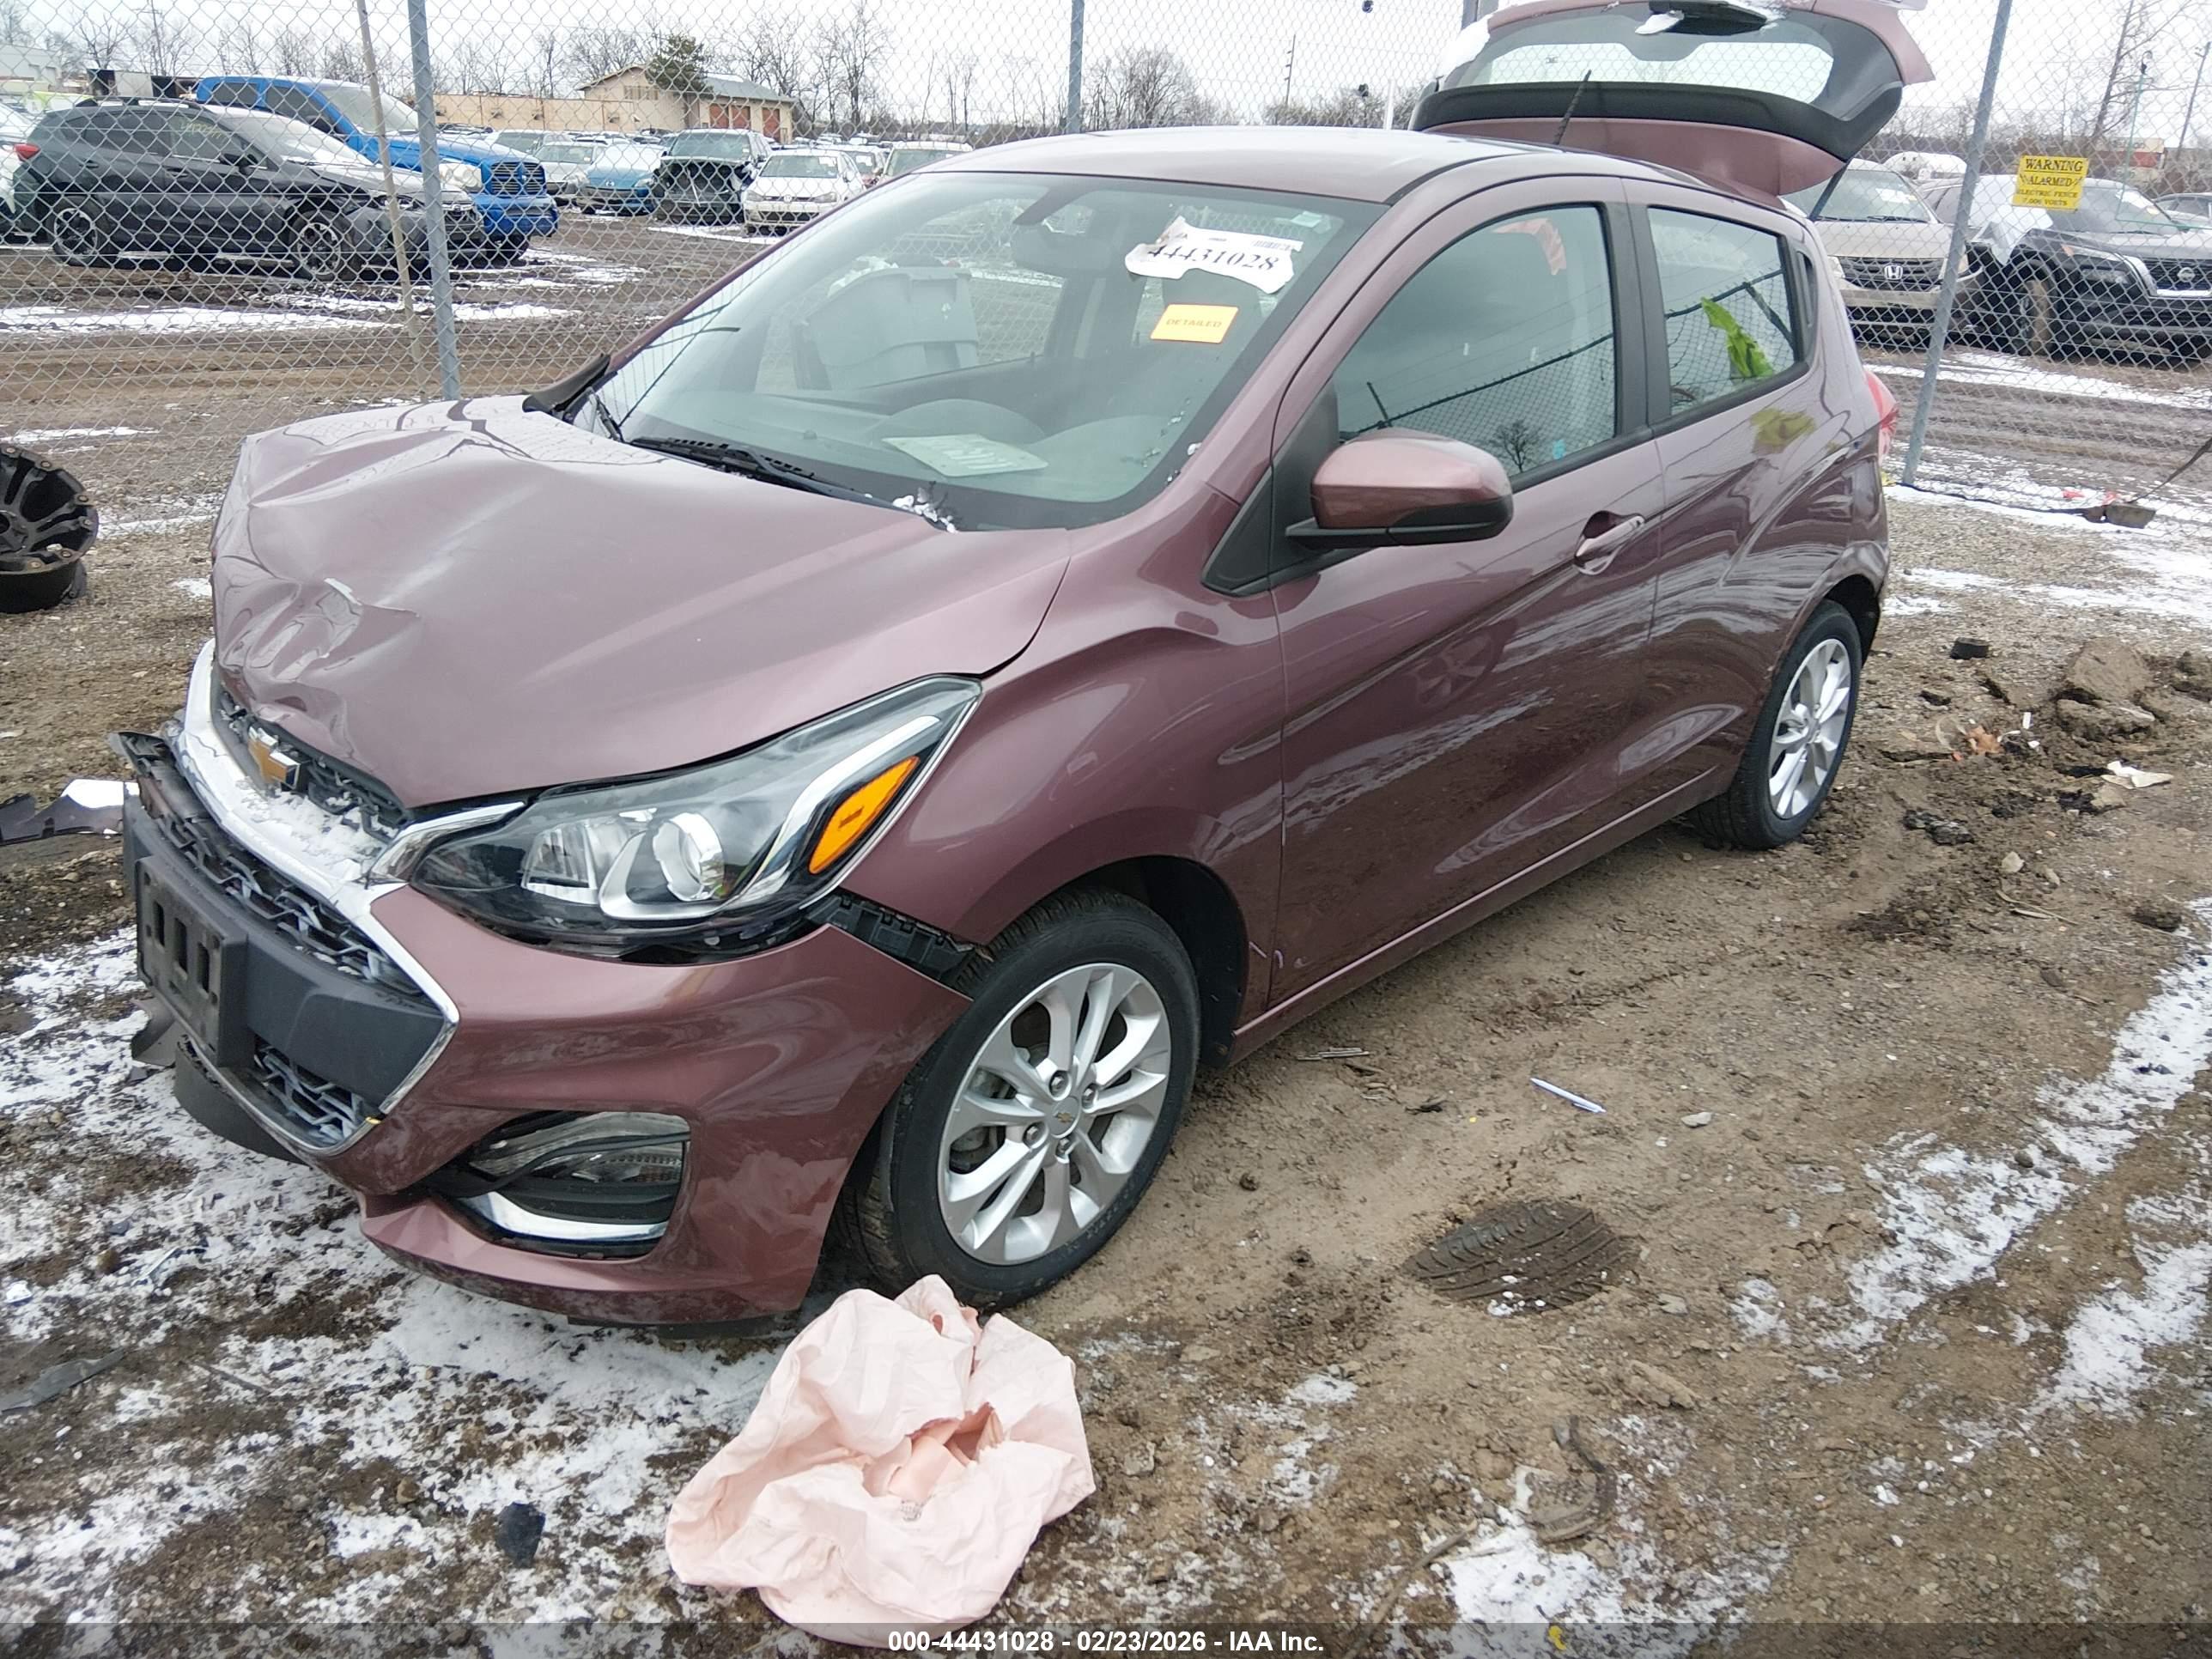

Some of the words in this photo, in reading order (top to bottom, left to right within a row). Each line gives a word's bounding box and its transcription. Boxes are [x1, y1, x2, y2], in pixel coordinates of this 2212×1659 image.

[2025, 158, 2083, 173] WARNING
[2027, 175, 2073, 187] ALARMED
[1146, 243, 1279, 271] 44431028
[1165, 318, 1223, 328] DETAILED
